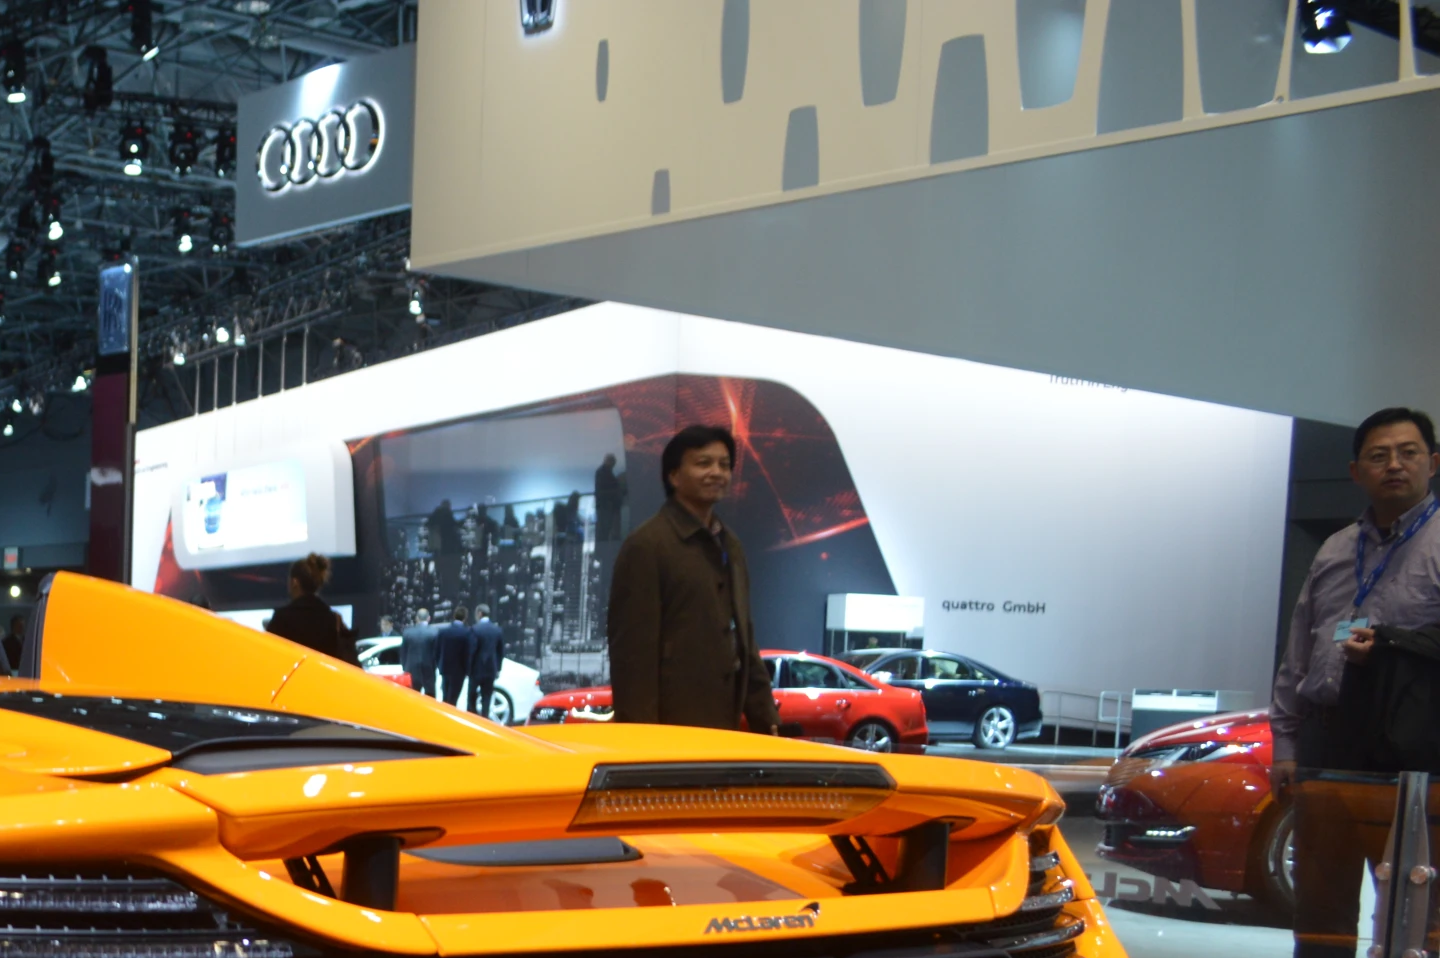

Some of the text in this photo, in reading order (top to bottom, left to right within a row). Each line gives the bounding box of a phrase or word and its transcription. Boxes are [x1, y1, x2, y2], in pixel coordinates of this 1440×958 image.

[941, 600, 1047, 614] quattro GmbH
[703, 914, 815, 935] McLaren
